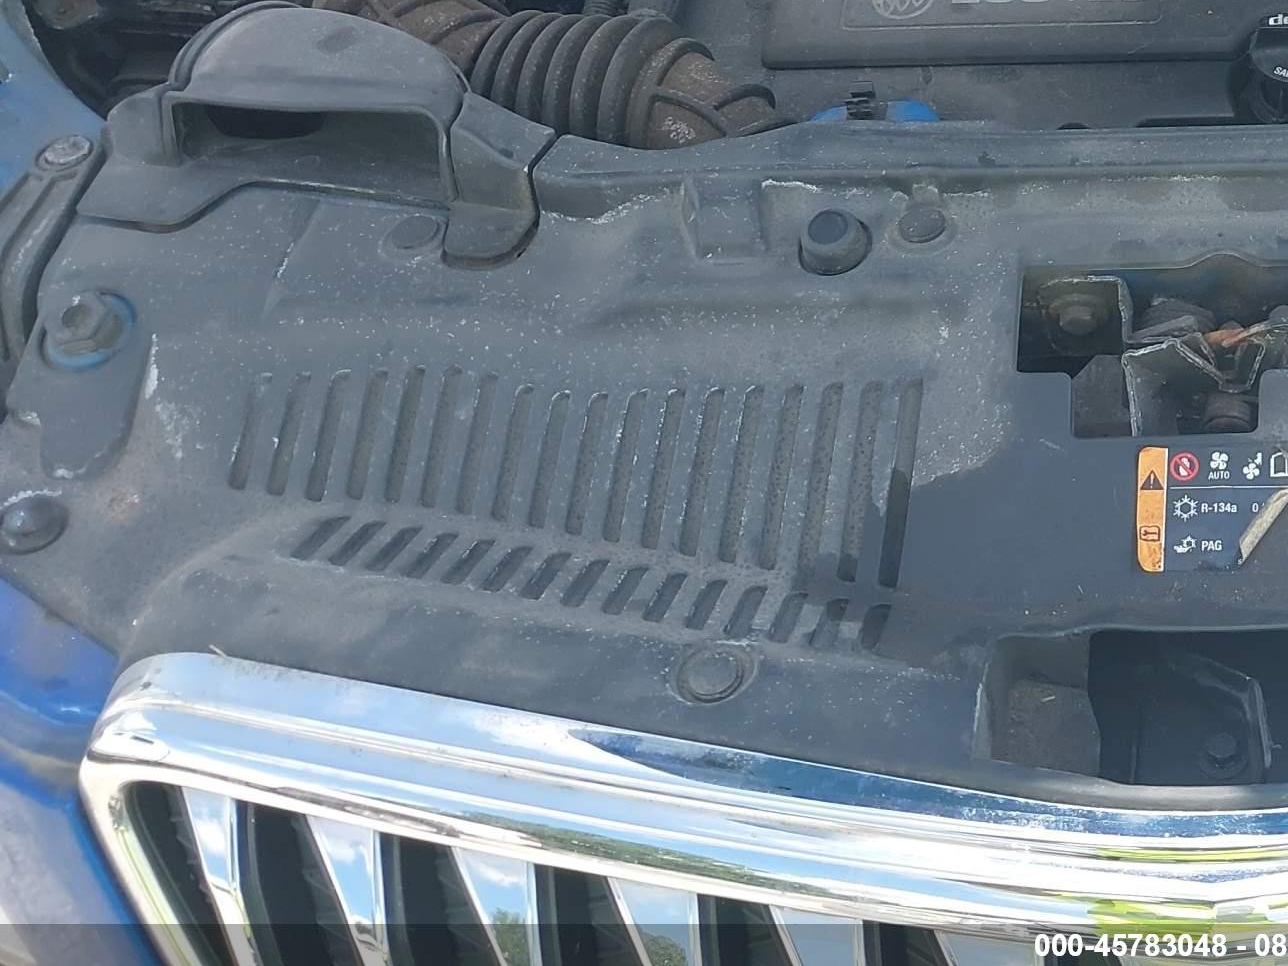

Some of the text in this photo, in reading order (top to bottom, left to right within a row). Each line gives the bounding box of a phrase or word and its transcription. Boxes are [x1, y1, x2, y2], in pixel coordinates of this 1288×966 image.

[1208, 471, 1230, 480] AUTO
[1201, 502, 1238, 513] R-134a
[1201, 540, 1223, 551] PAG
